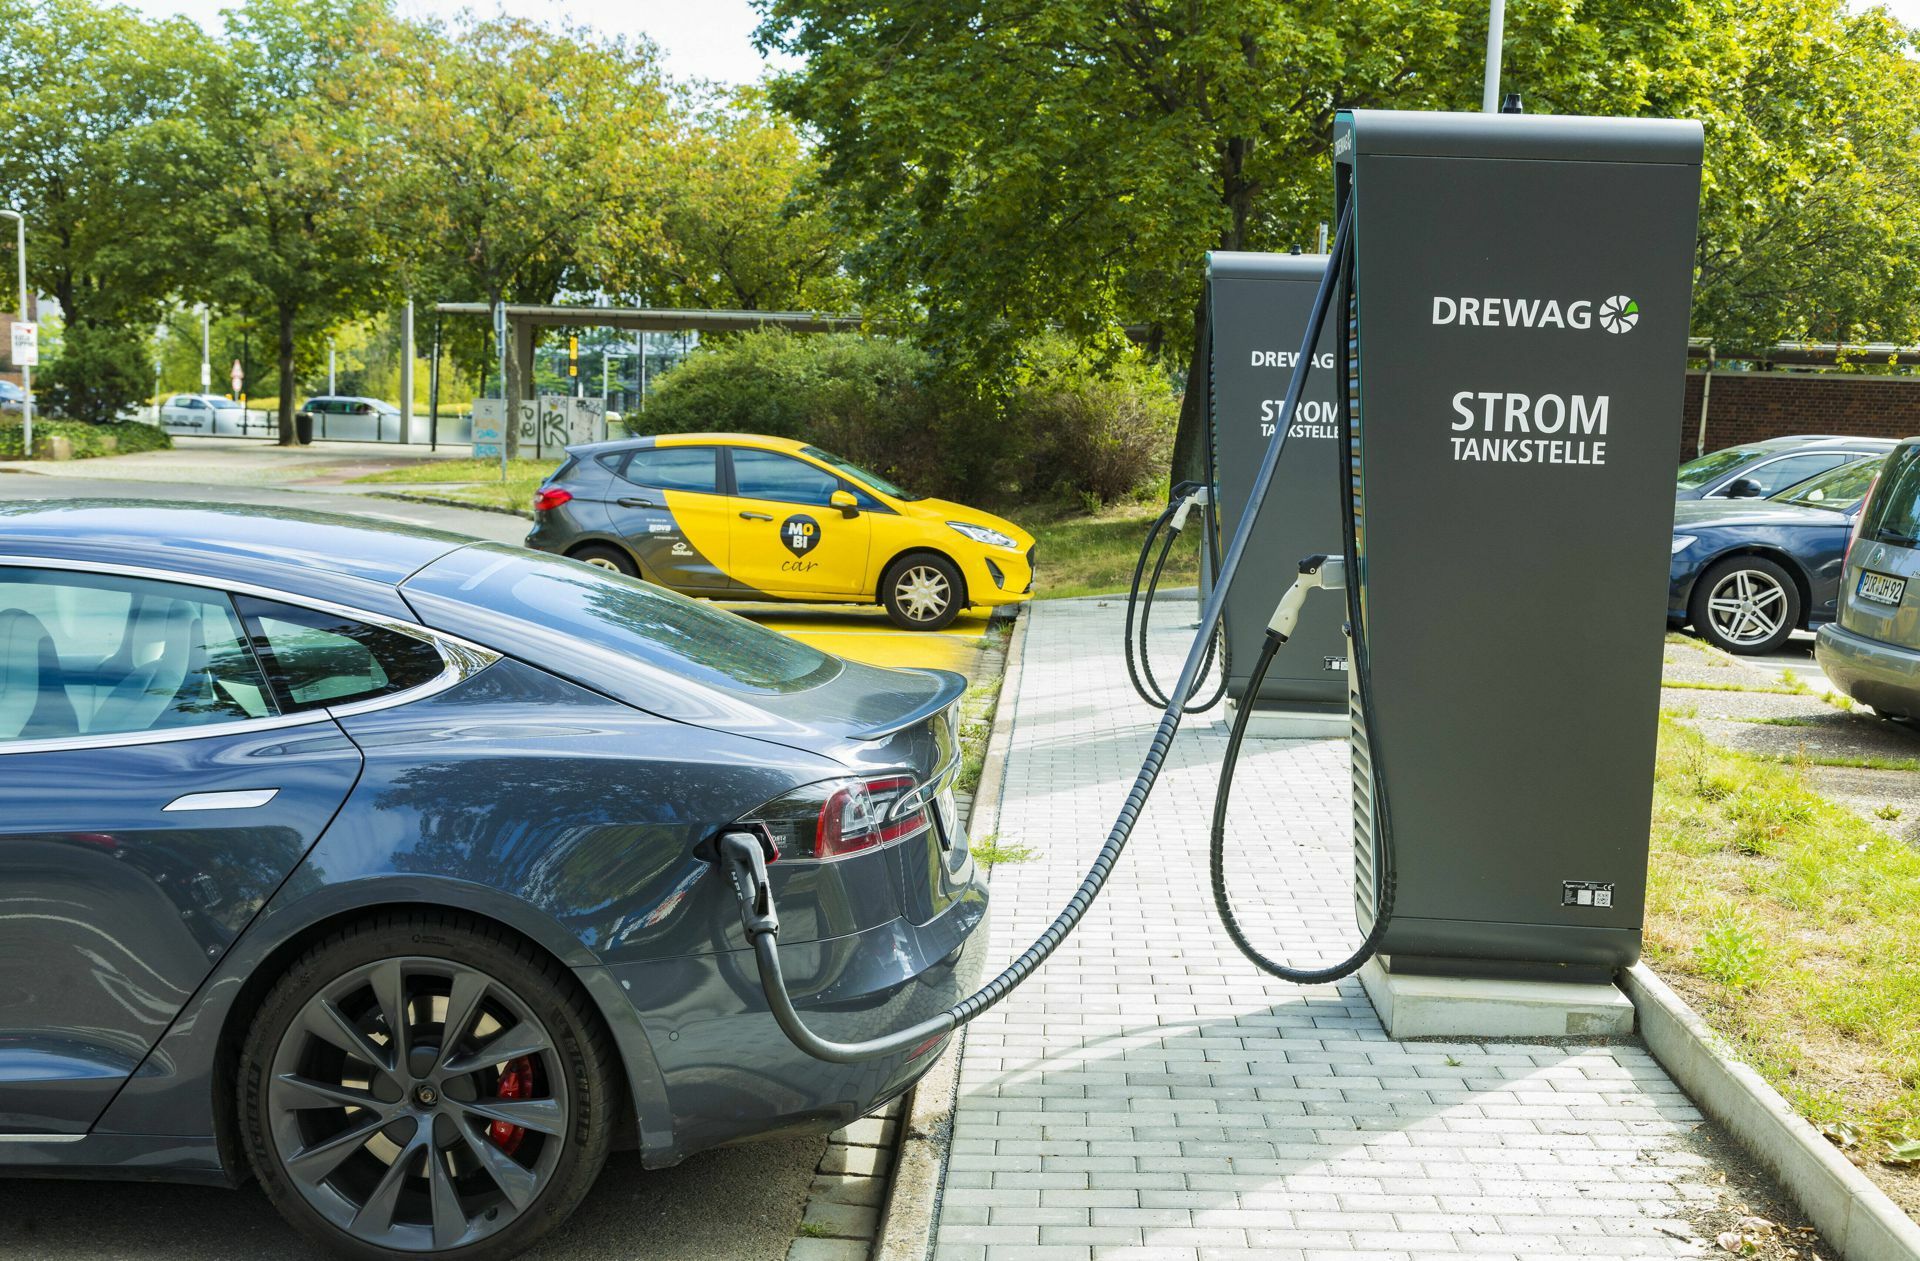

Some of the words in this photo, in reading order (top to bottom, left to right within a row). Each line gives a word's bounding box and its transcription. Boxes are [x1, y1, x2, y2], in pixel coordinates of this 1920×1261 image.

[1432, 296, 1592, 330] DREWAG
[1451, 391, 1610, 435] STROM
[1260, 423, 1338, 439] TAKSTELLE
[1450, 437, 1606, 465] TANKSTELLE
[781, 560, 818, 572] car
